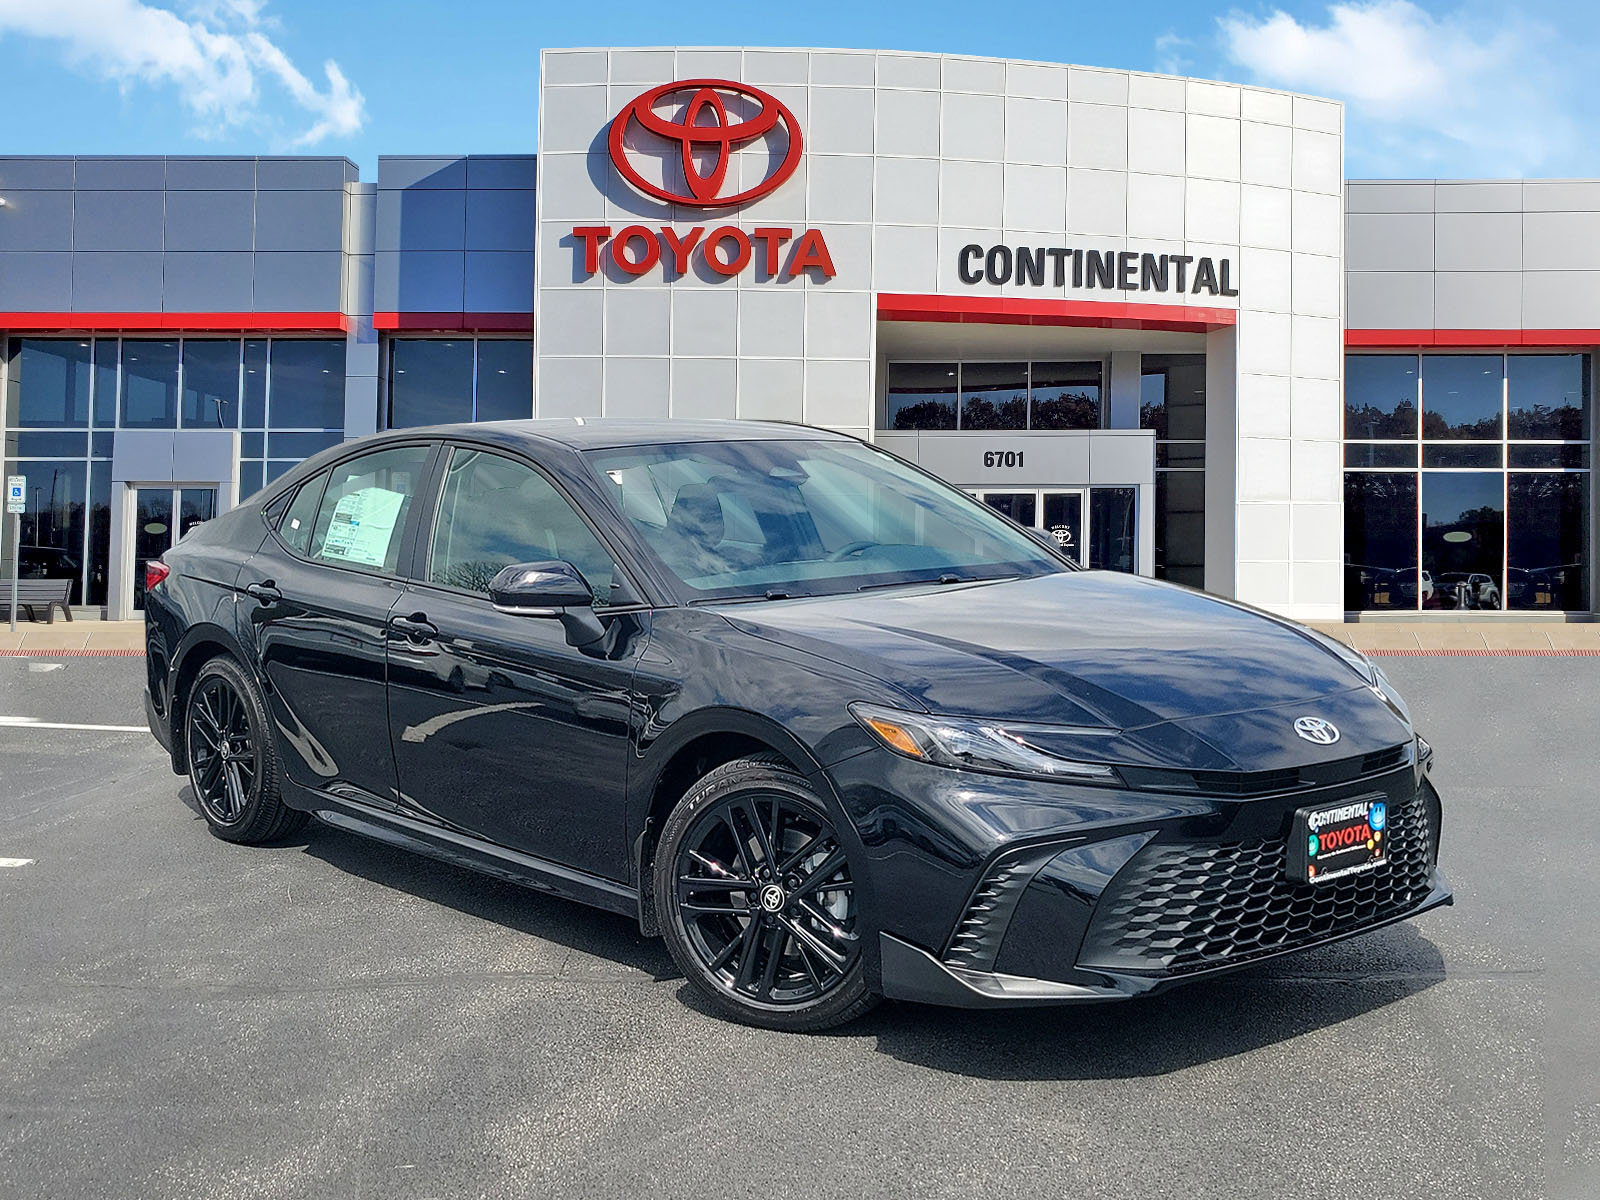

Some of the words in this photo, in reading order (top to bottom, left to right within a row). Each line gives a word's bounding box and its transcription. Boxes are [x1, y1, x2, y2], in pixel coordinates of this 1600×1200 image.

[572, 225, 836, 276] TOYOTA
[958, 244, 1239, 297] CONTINENTAL
[983, 451, 1024, 468] 6701
[1308, 802, 1369, 831] CONTINENTAL
[1319, 824, 1372, 851] TOYOTA
